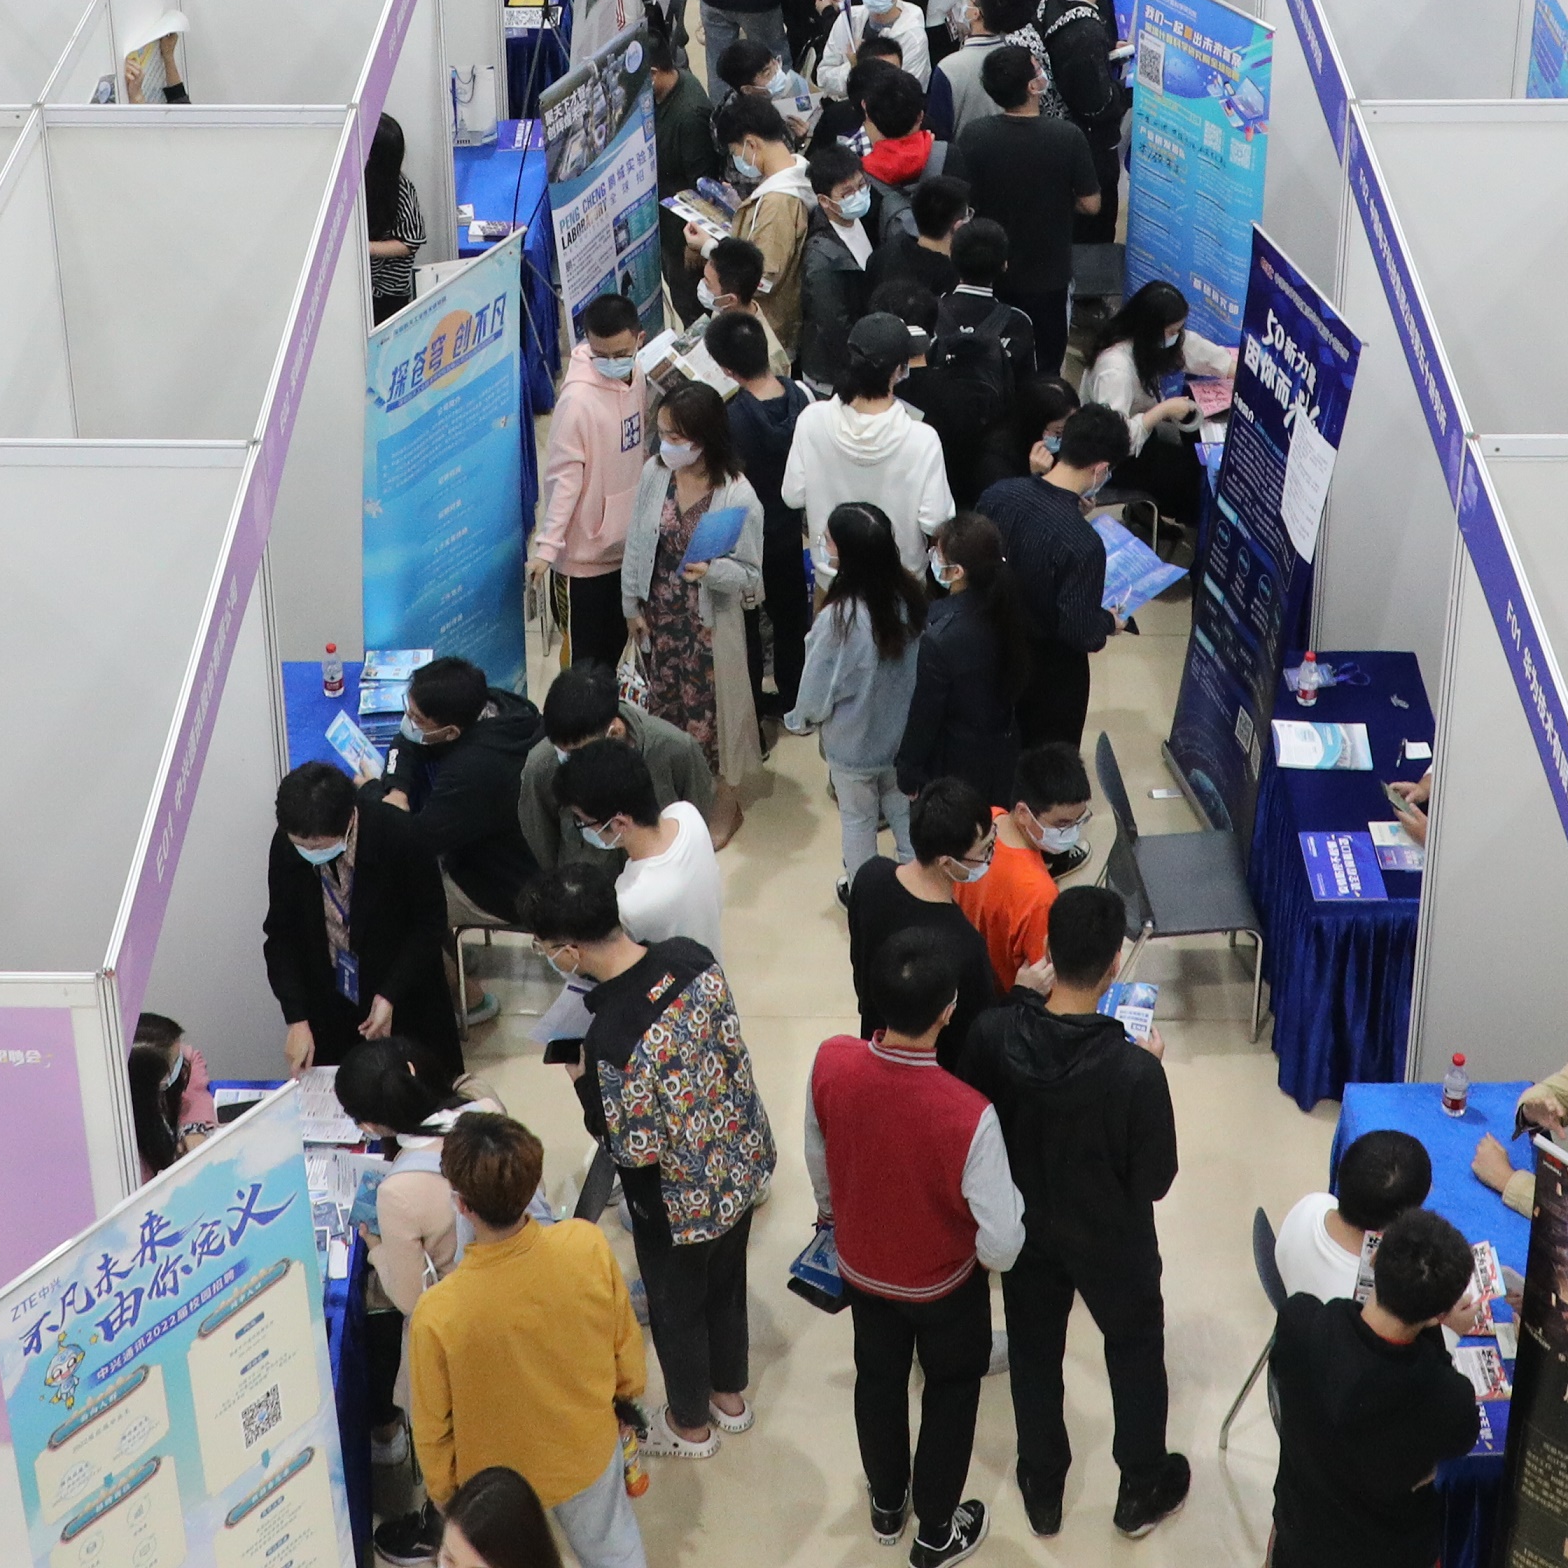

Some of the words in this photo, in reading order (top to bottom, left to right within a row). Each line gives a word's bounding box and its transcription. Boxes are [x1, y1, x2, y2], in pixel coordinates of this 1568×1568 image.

[559, 209, 582, 235] PENG
[582, 187, 607, 214] CHENG
[387, 332, 448, 403] 探苍穹
[452, 291, 508, 359] 创不凡
[1504, 598, 1524, 650] F01
[152, 809, 184, 882] E01
[19, 1209, 204, 1357] 不凡未来
[94, 1182, 298, 1344] 由你定义
[96, 1268, 236, 1381] 中兴通讯2022届校园招聘
